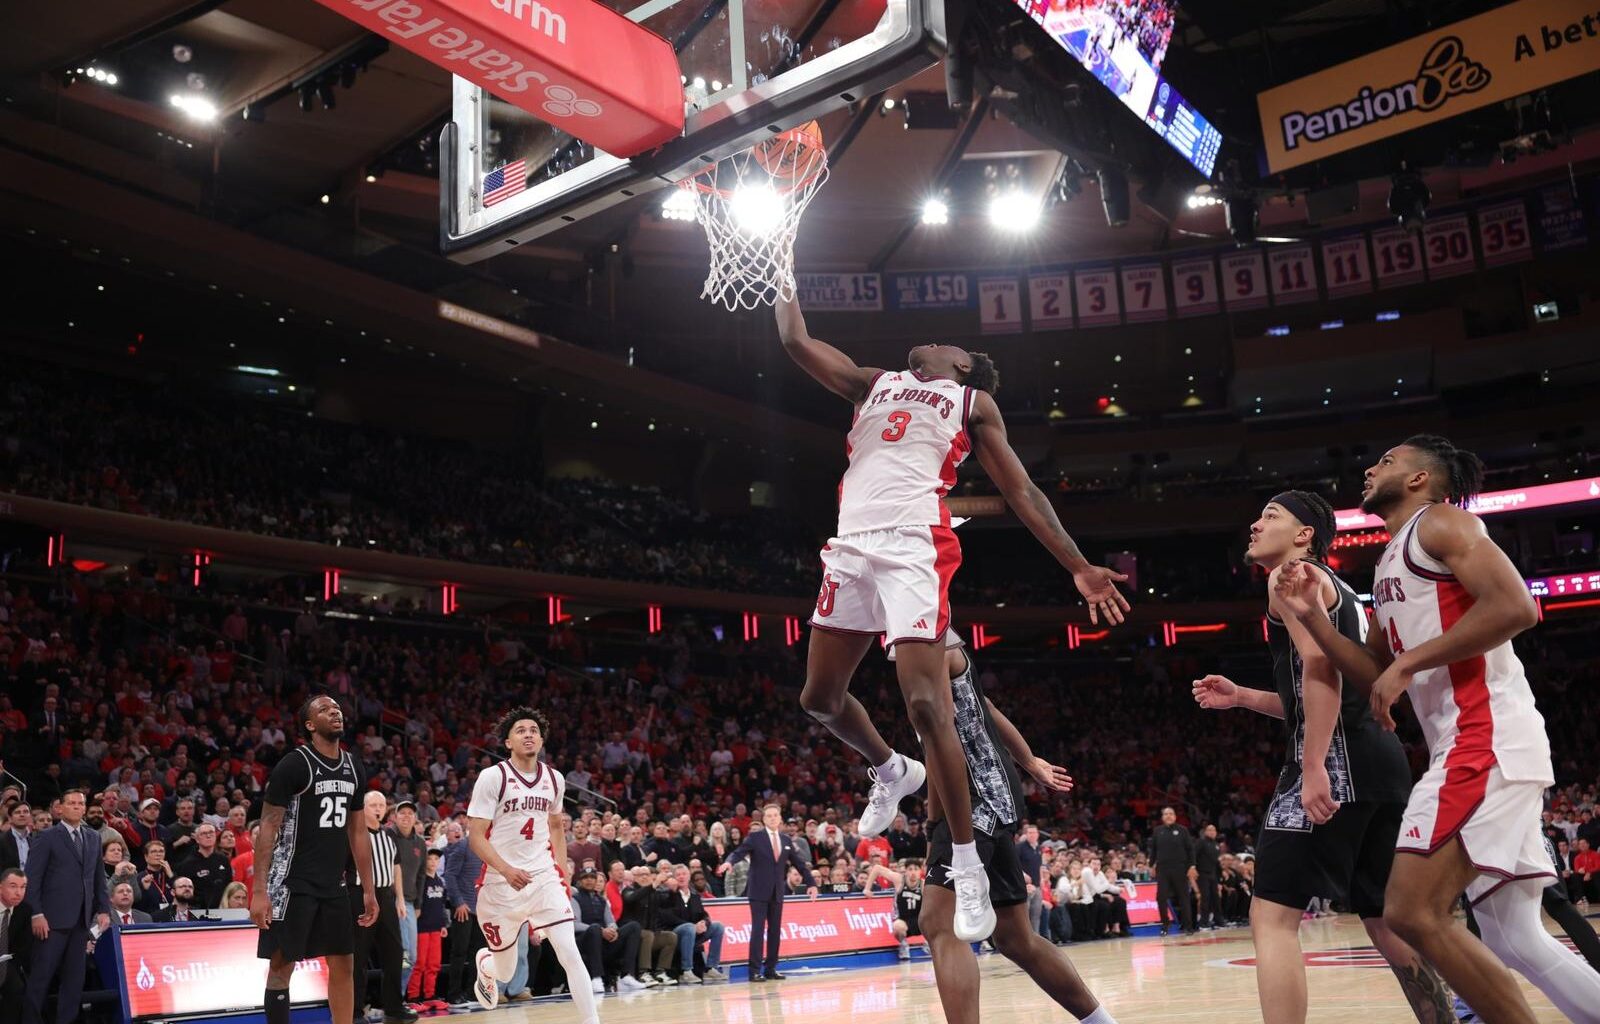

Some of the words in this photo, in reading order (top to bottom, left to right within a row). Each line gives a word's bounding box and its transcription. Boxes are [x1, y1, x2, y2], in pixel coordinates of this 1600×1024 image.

[1515, 33, 1536, 62] A
[1541, 11, 1600, 53] bet
[1429, 231, 1468, 264] 30
[1483, 217, 1526, 252] 35
[1333, 253, 1361, 284] 11
[1381, 242, 1415, 274] 19
[799, 275, 840, 288] HARRY
[852, 275, 877, 301] 15
[925, 275, 968, 302] 150
[1186, 275, 1205, 302] 9
[1236, 268, 1253, 295] 9
[1280, 261, 1307, 290] 11
[798, 288, 846, 301] STYLES
[993, 294, 1006, 320] 1
[1042, 289, 1059, 316] 2
[1089, 286, 1106, 312] 3
[1135, 281, 1152, 309] 7
[892, 388, 955, 420] JOHN'S
[881, 410, 912, 442] 3
[1383, 617, 1405, 655] 4
[315, 780, 355, 796] GEORGETOWN
[319, 796, 347, 829] 25
[503, 798, 519, 814] ST.
[520, 817, 535, 840] 4
[833, 884, 849, 893] POSS
[906, 898, 917, 910] 11
[725, 923, 788, 945] Sulln
[788, 919, 839, 943] Papain
[845, 906, 893, 936] Injury
[162, 961, 238, 984] Sulliv
